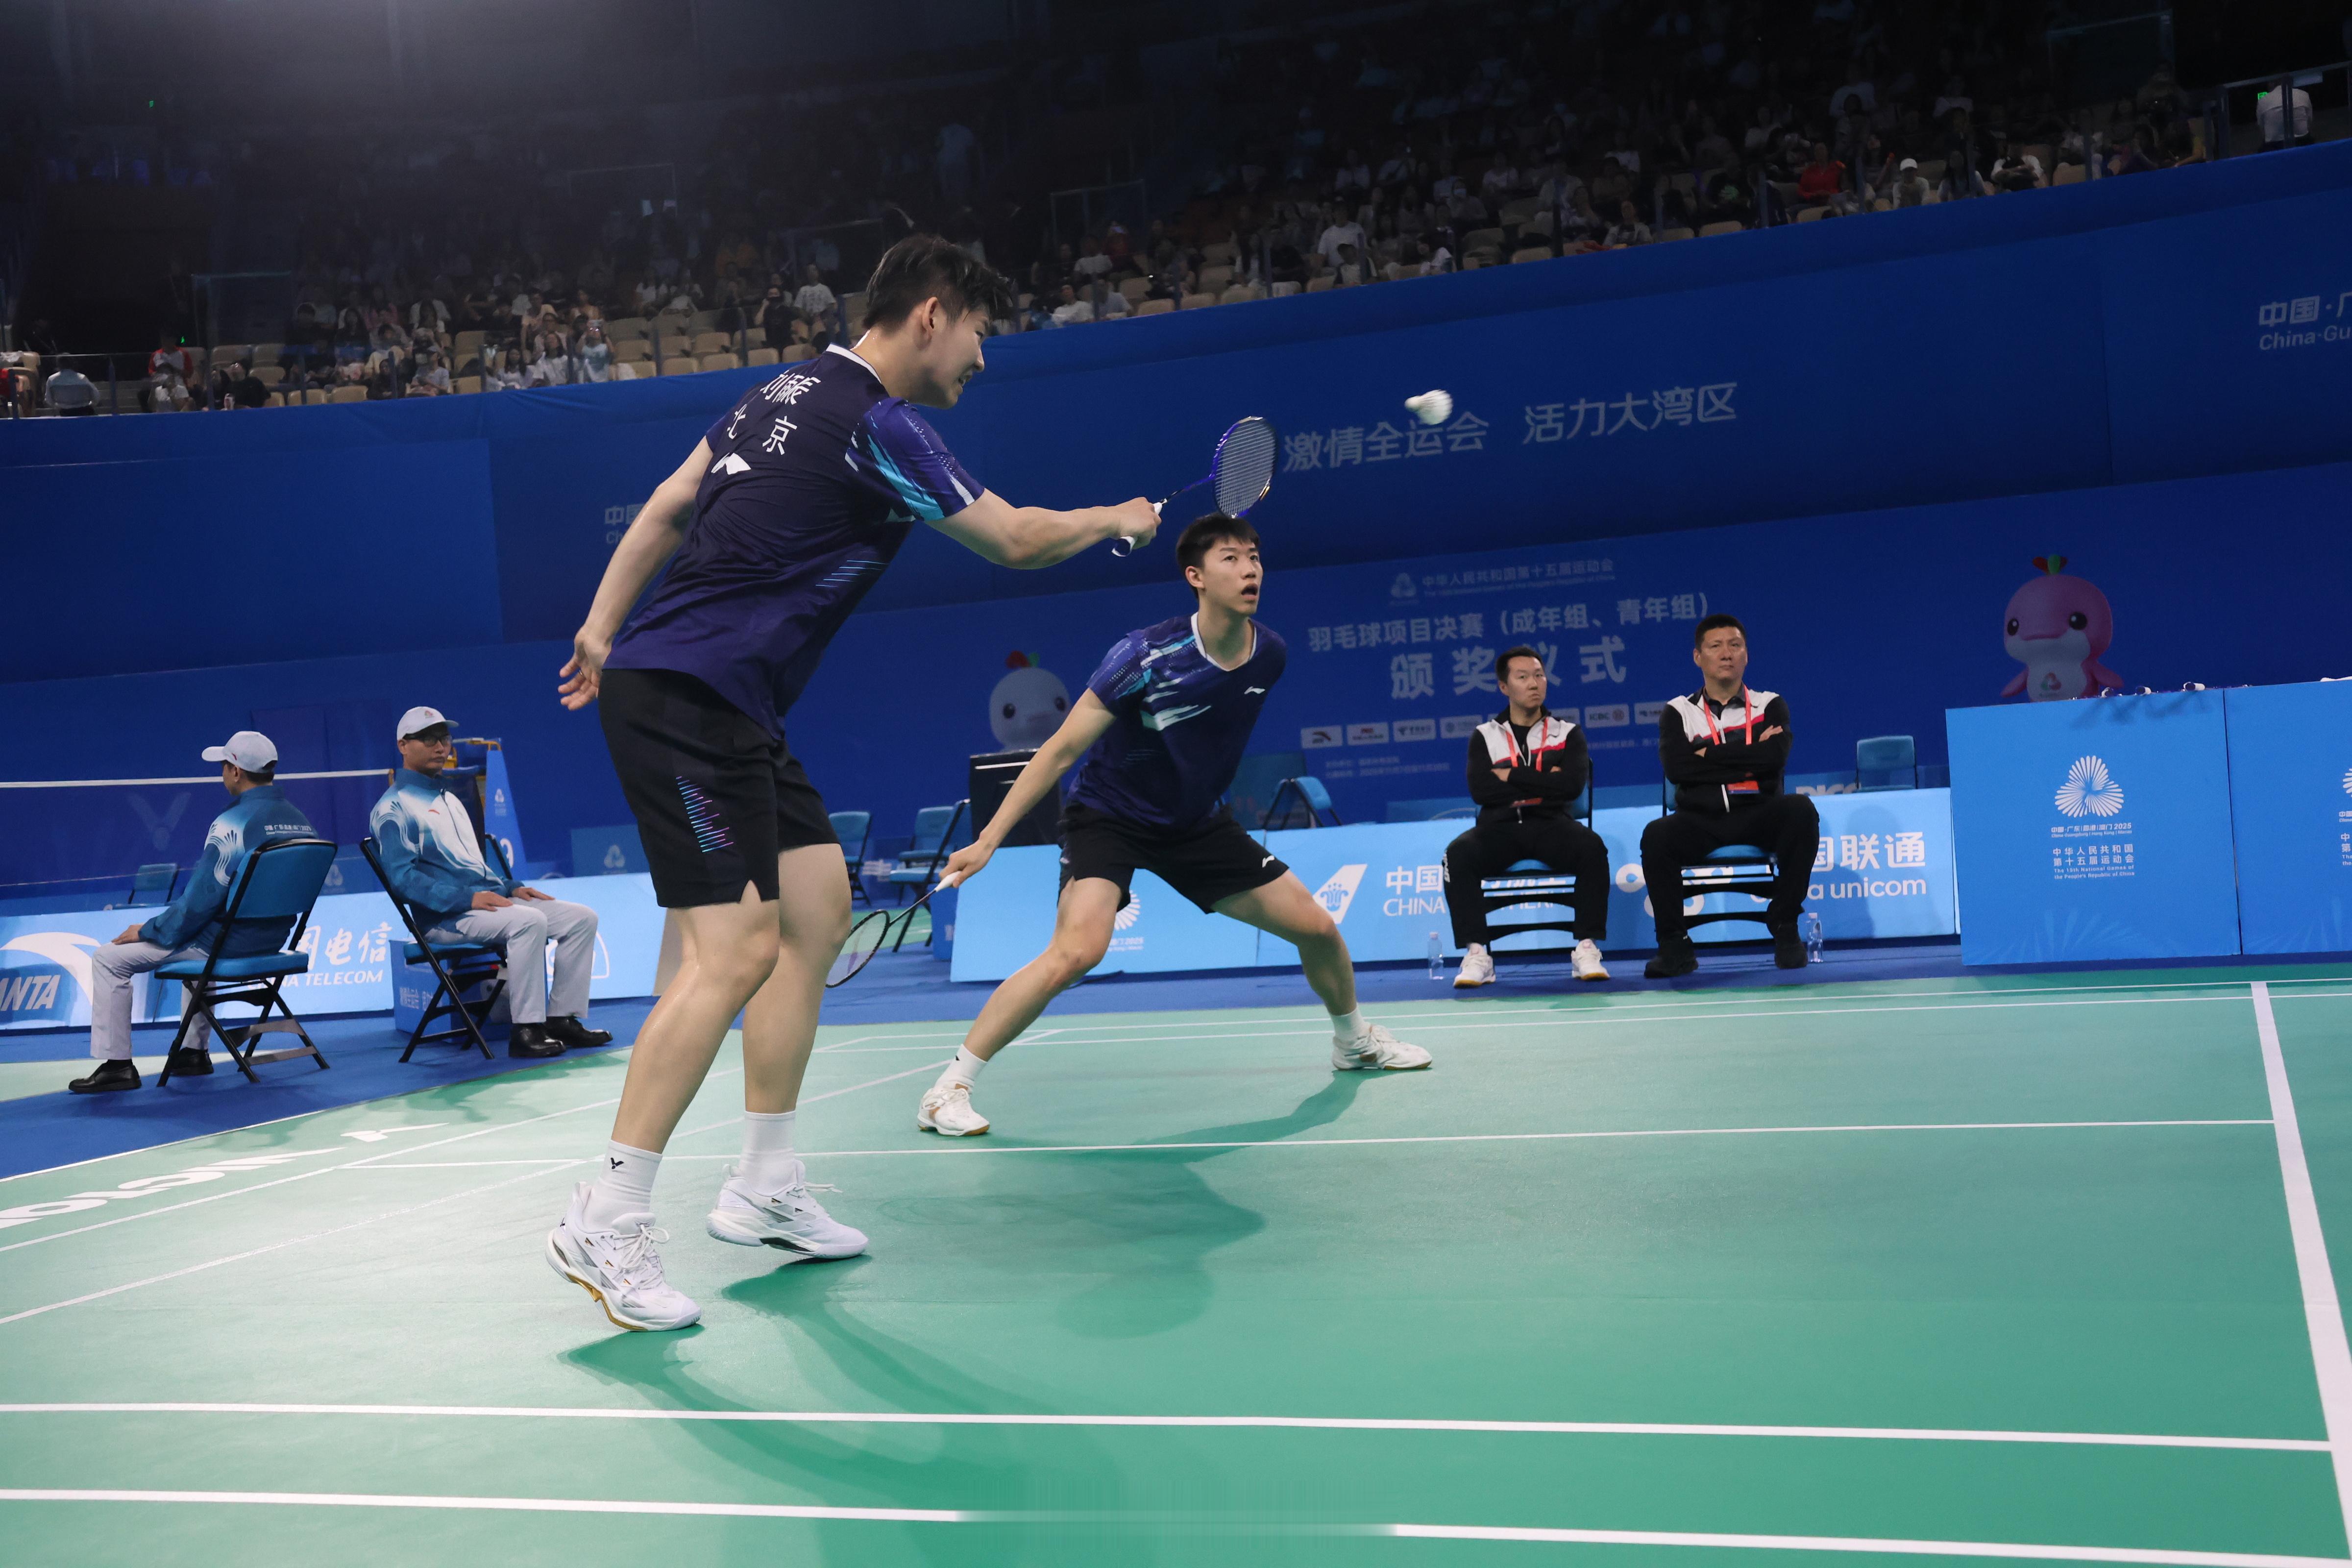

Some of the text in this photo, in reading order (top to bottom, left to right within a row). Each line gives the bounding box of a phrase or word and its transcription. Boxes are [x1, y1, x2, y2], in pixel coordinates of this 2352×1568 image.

[1283, 382, 1738, 472] 激情全运会 活力大湾区
[2341, 833, 2350, 842] 中
[2053, 844, 2133, 857] 中华人民共和国
[2054, 854, 2134, 867] 第十五届运动会
[1386, 865, 1444, 895] 中国
[1831, 877, 1926, 899] unicom
[1383, 896, 1446, 916] CHINA
[305, 970, 384, 987] TELECOM
[0, 1147, 346, 1228] VICTO
